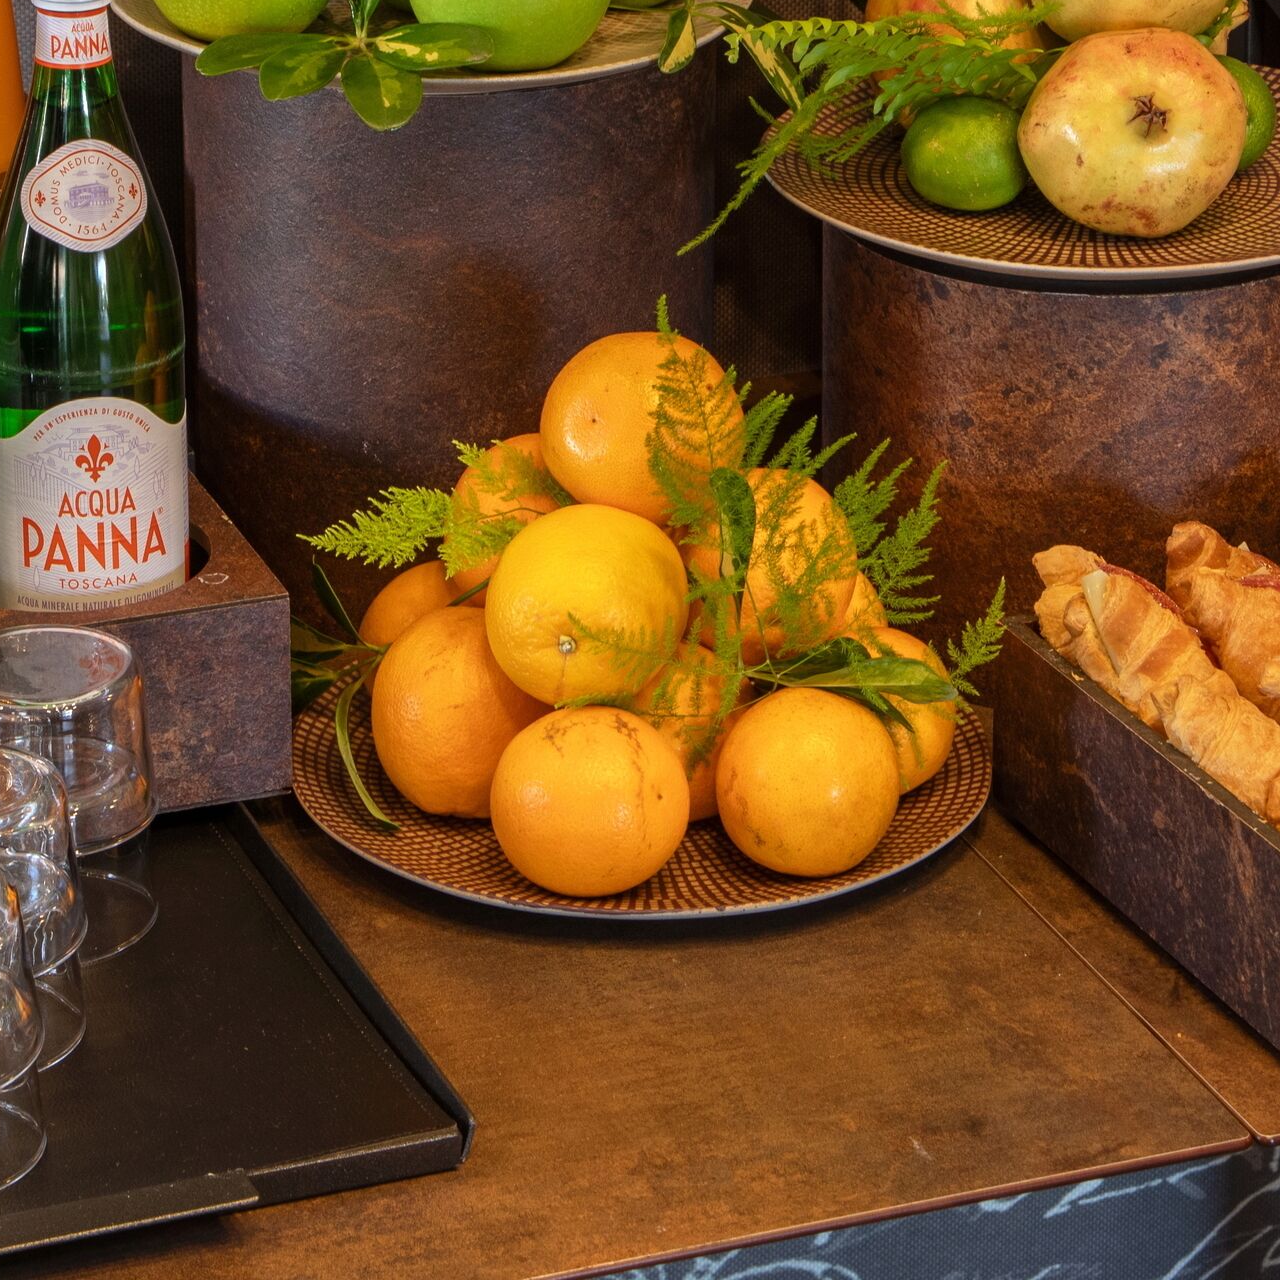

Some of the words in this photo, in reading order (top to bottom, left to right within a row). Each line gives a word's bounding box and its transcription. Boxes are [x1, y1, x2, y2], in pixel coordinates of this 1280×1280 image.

[71, 22, 95, 33] ACQUA
[50, 32, 109, 59] PANNA
[50, 179, 68, 224] DOMUS
[59, 155, 100, 177] MEDICI
[106, 163, 126, 220] TOSCANA
[77, 224, 108, 235] 1564
[33, 429, 44, 441] PER
[44, 408, 98, 431] UN'ESPERIENZA
[102, 407, 110, 415] DI
[113, 408, 134, 420] GUSTO
[135, 415, 151, 433] UNICA
[58, 486, 136, 518] ACQUA
[22, 511, 167, 573] PANNA
[59, 572, 138, 590] TOSCANA
[17, 594, 40, 609] ACQUA
[41, 600, 80, 612] MINERALE
[82, 598, 122, 612] NATURALE
